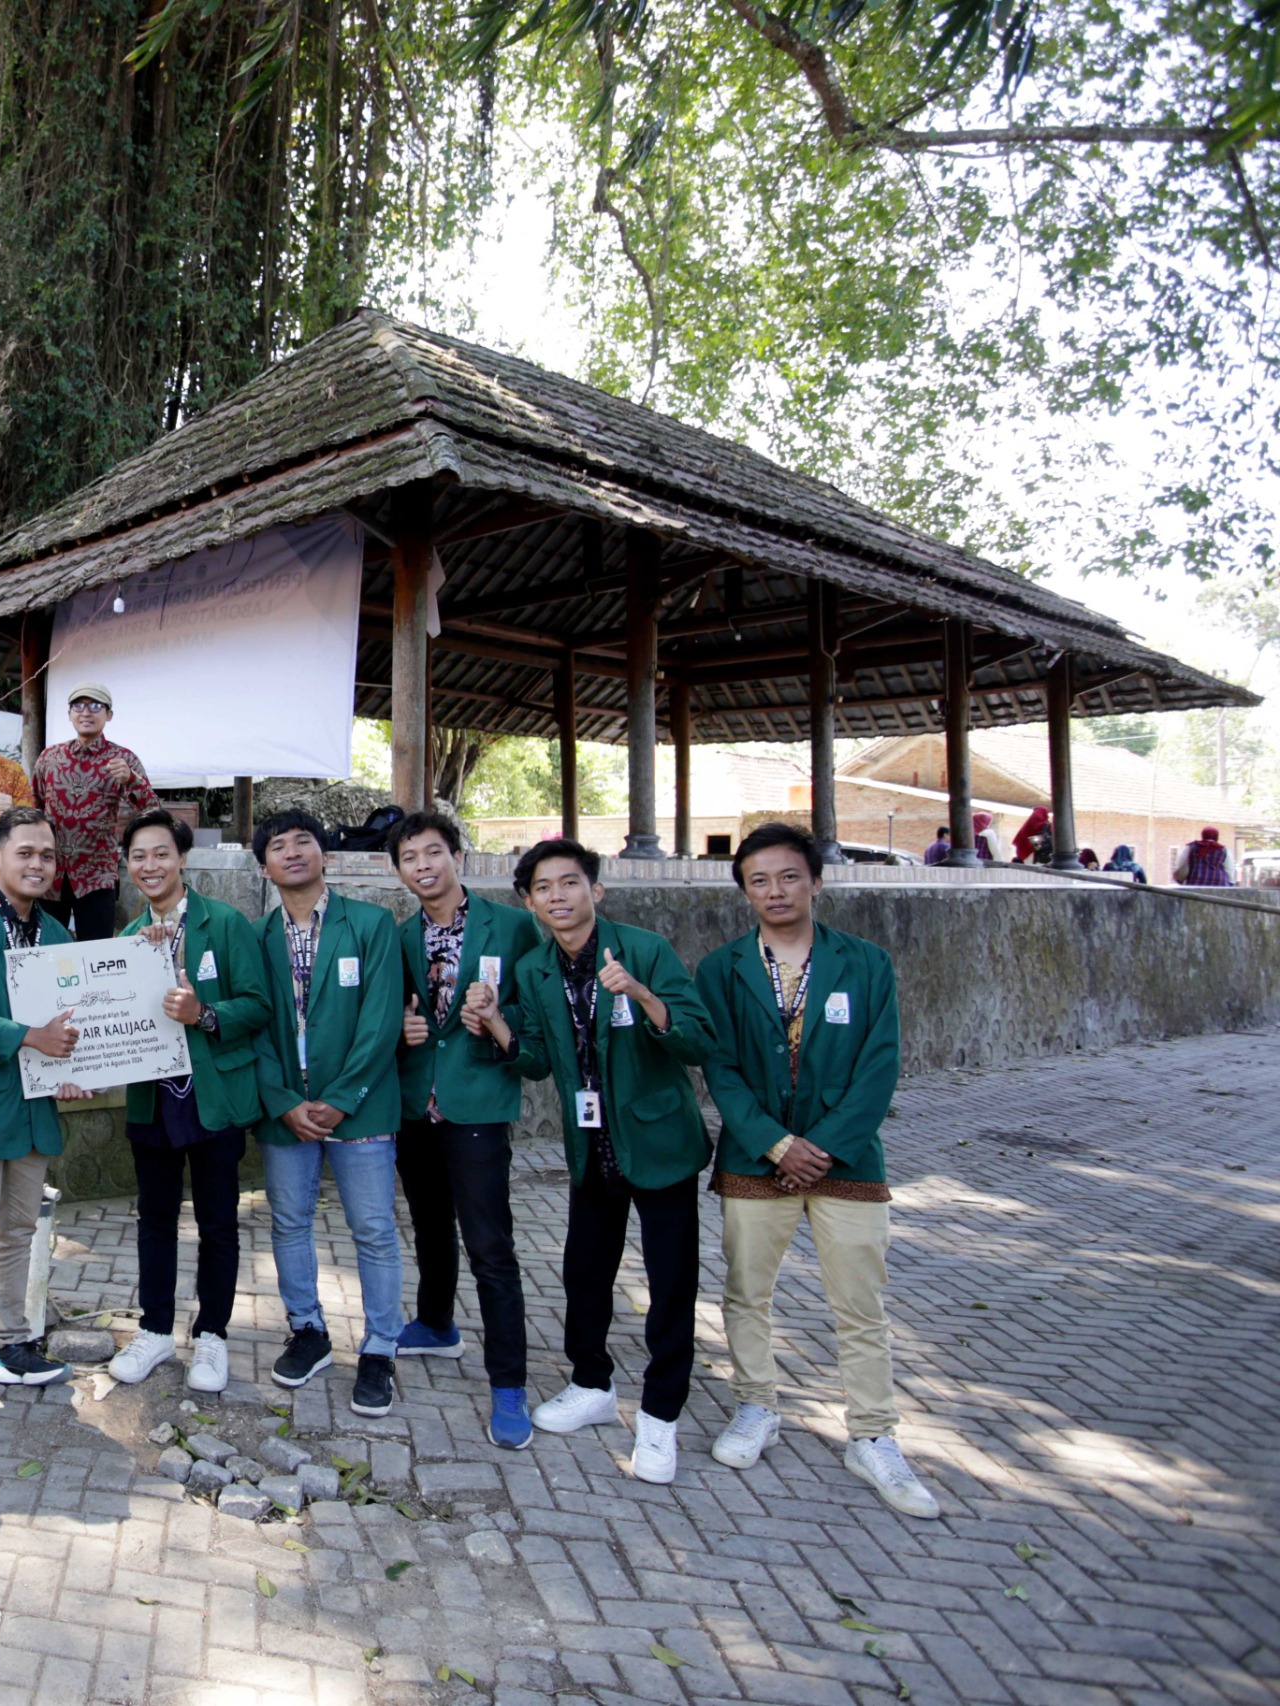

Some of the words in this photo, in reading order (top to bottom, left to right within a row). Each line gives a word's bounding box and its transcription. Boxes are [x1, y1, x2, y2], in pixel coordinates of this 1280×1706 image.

[799, 975, 808, 991] SUKA
[69, 1016, 88, 1024] Dengan
[88, 1013, 107, 1021] Rahmat
[83, 1026, 102, 1039] AIR
[104, 1018, 156, 1036] KALIJAGA
[141, 1036, 158, 1045] kepada
[84, 1063, 102, 1072] tanggal
[111, 1059, 130, 1068] Agustus
